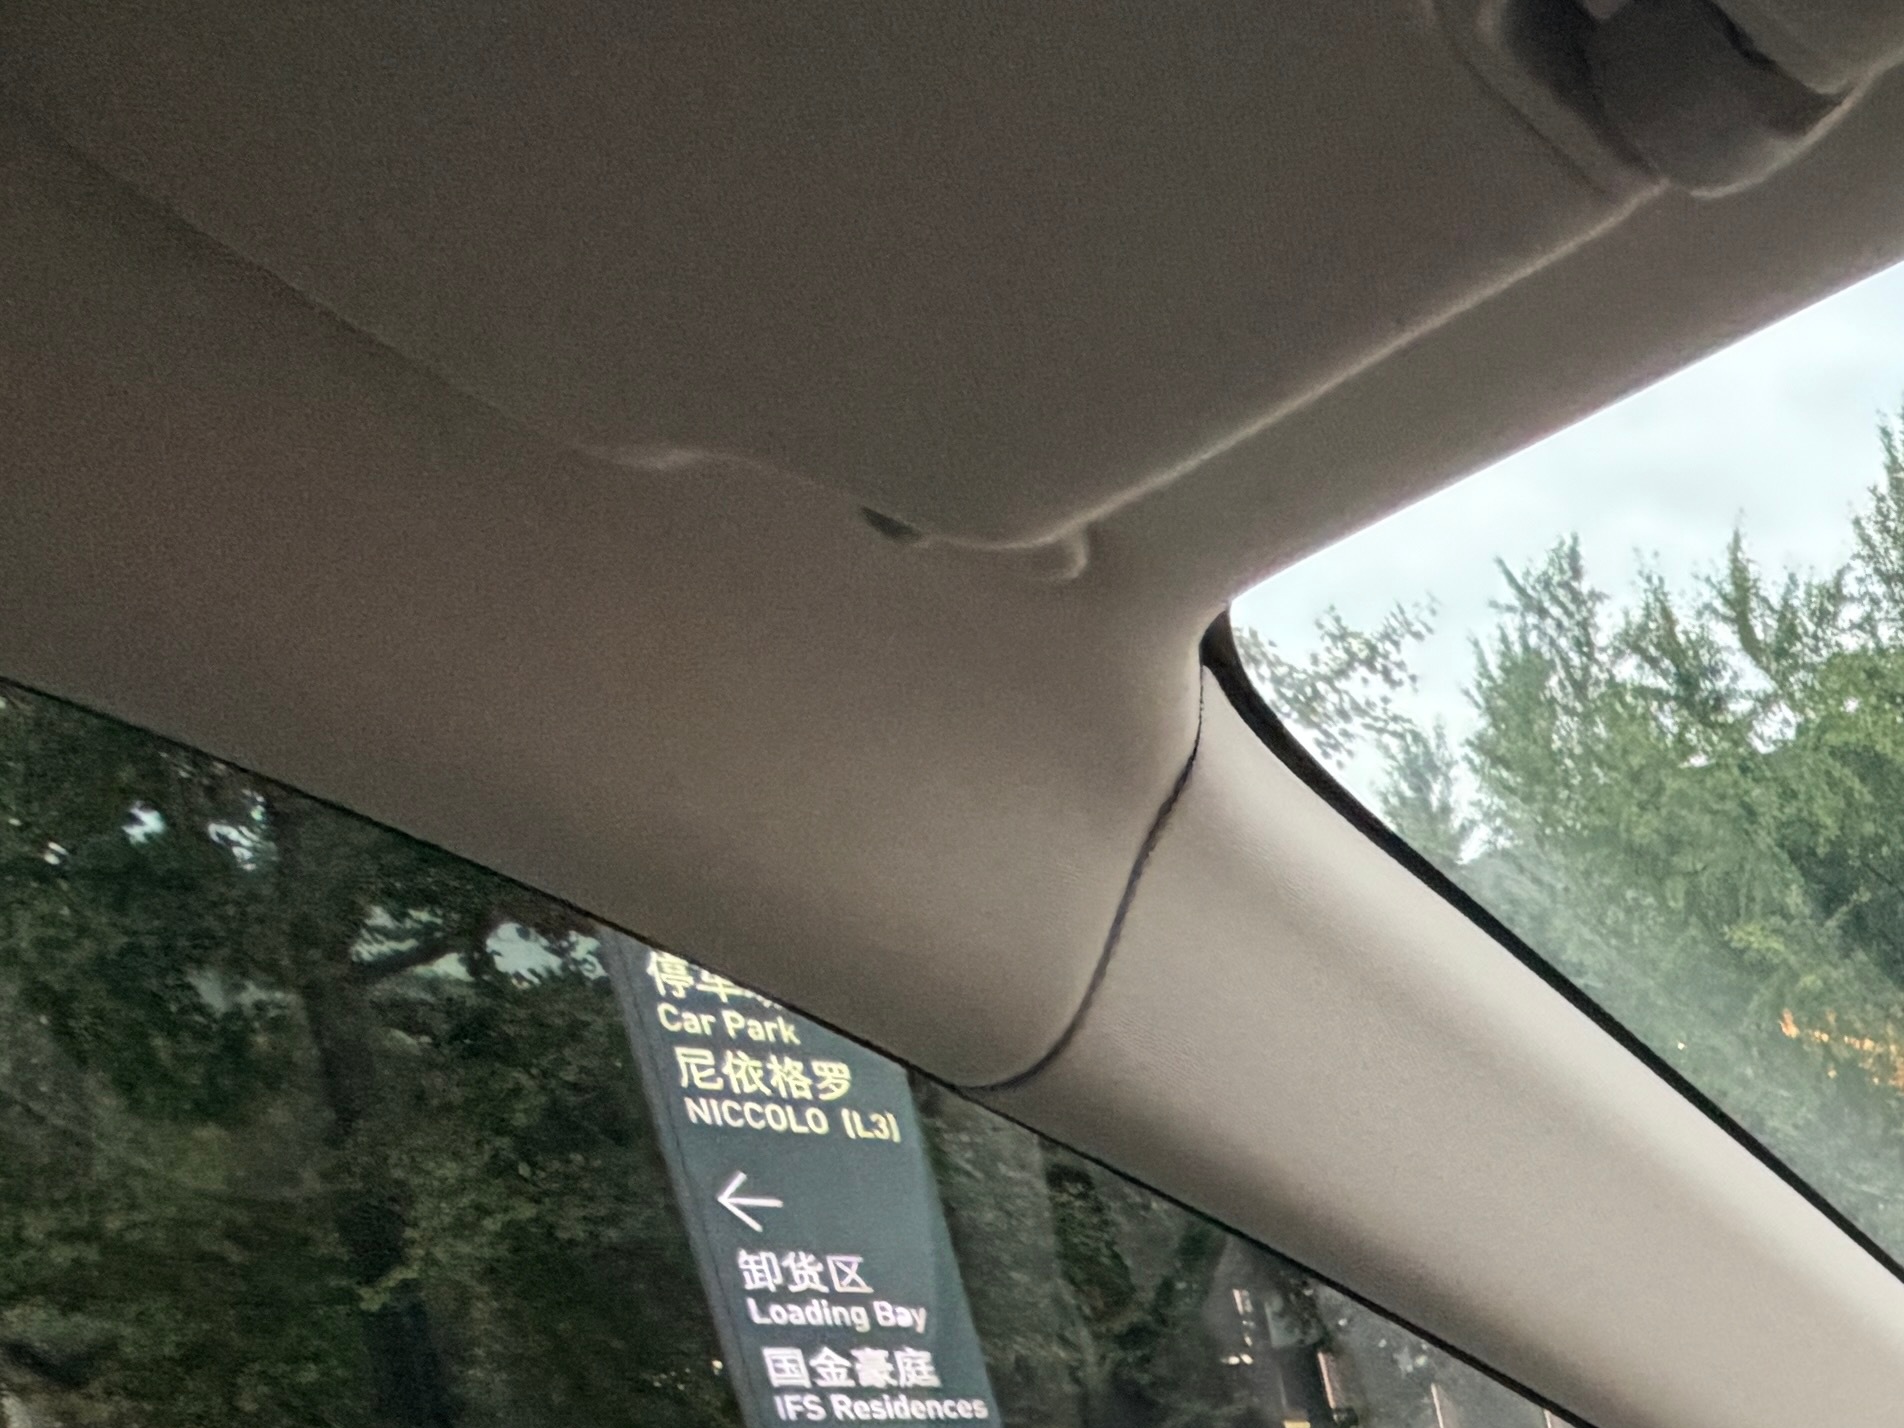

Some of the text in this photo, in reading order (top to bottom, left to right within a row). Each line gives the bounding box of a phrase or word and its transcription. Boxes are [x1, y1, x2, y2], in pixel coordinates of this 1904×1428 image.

[646, 950, 782, 1010] 停车
[657, 1003, 801, 1045] Car Park
[674, 1046, 852, 1101] 尼依格罗
[684, 1097, 830, 1135] NICCOLO
[738, 1249, 874, 1293] 卸货区
[745, 1298, 927, 1332] Loading Bay
[761, 1345, 942, 1389] 国金豪庭
[774, 1393, 989, 1422] IFS Residences
